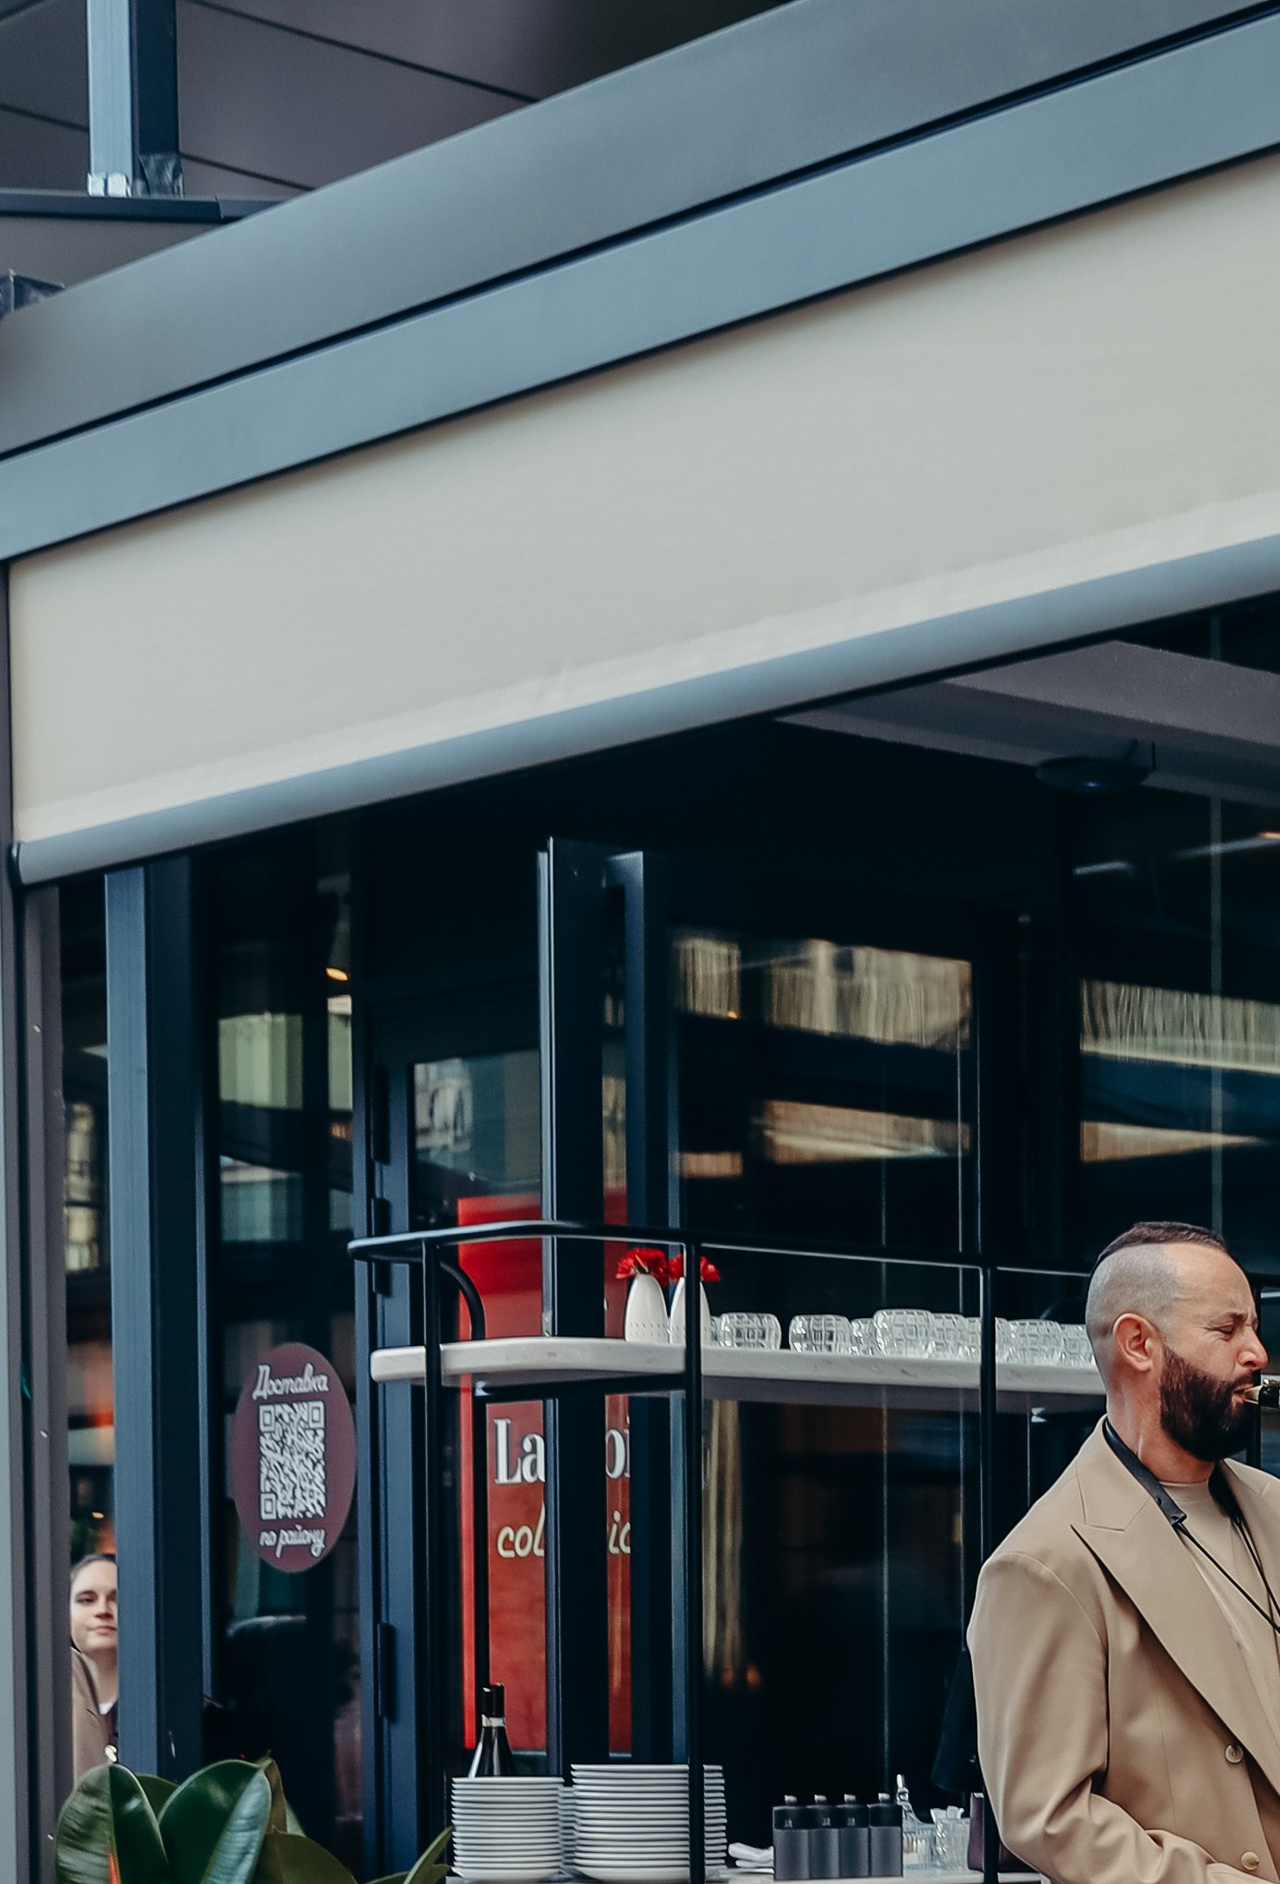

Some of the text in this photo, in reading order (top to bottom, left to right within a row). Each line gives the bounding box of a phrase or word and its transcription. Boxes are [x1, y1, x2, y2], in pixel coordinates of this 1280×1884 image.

[252, 1363, 329, 1400] Доставка
[493, 1418, 545, 1484] La
[260, 1523, 326, 1559] по району
